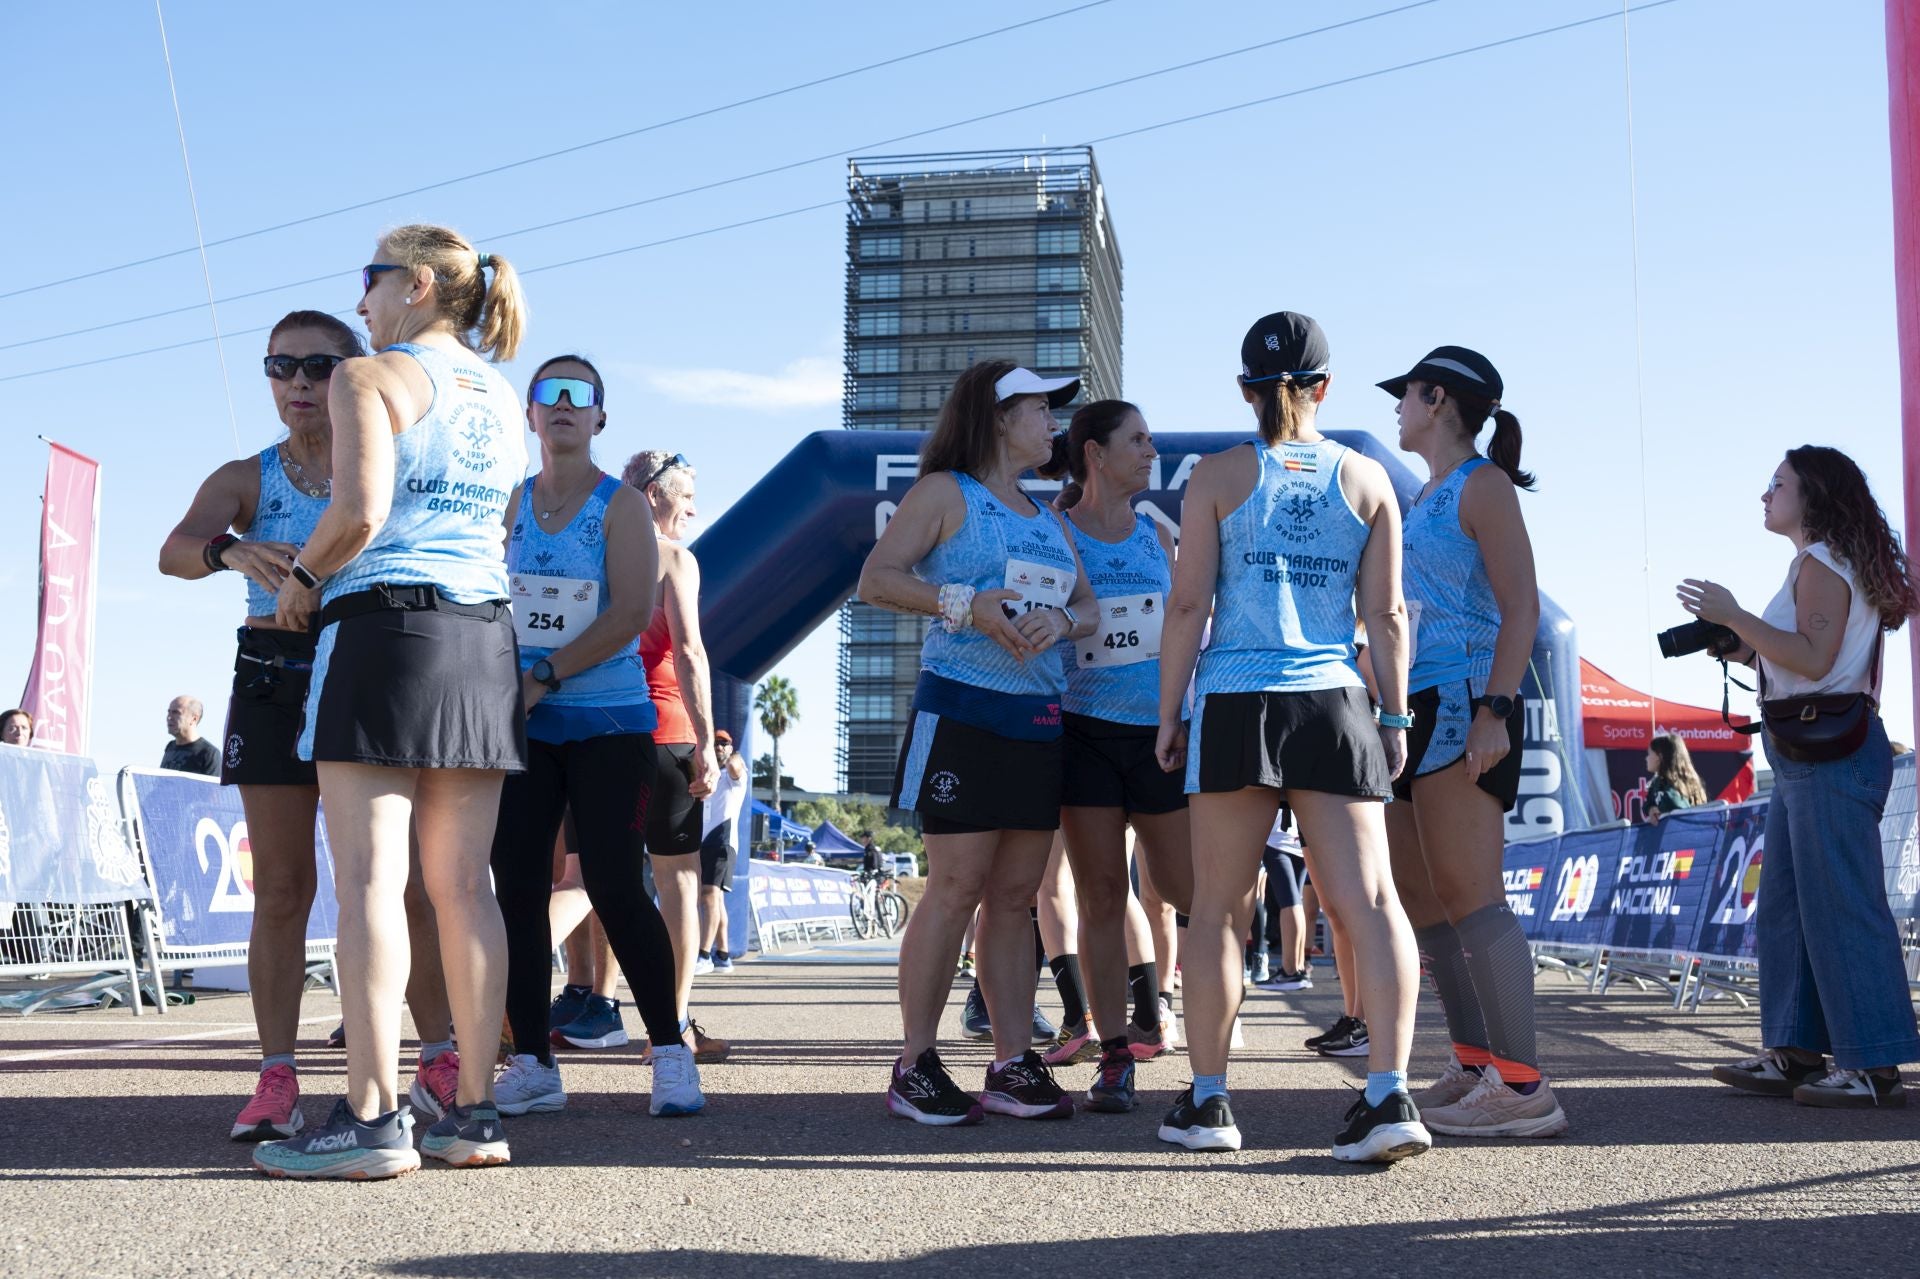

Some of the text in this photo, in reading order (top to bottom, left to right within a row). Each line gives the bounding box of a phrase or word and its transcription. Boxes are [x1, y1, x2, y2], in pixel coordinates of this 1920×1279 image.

[1284, 451, 1317, 460] VIATOR
[407, 478, 449, 494] CLUB
[1272, 481, 1330, 509] CLUB MARATON
[1275, 523, 1322, 544] BADAJOZ
[1244, 551, 1349, 573] CLUB MARATON
[1264, 569, 1328, 588] BADAJOZ
[528, 612, 565, 631] 254
[1104, 630, 1140, 650] 426
[1582, 695, 1650, 708] tander
[1603, 724, 1645, 741] Sports
[1670, 727, 1734, 740] Santander
[1611, 886, 1680, 915] NACIONAL
[305, 1129, 358, 1153] HOKA
